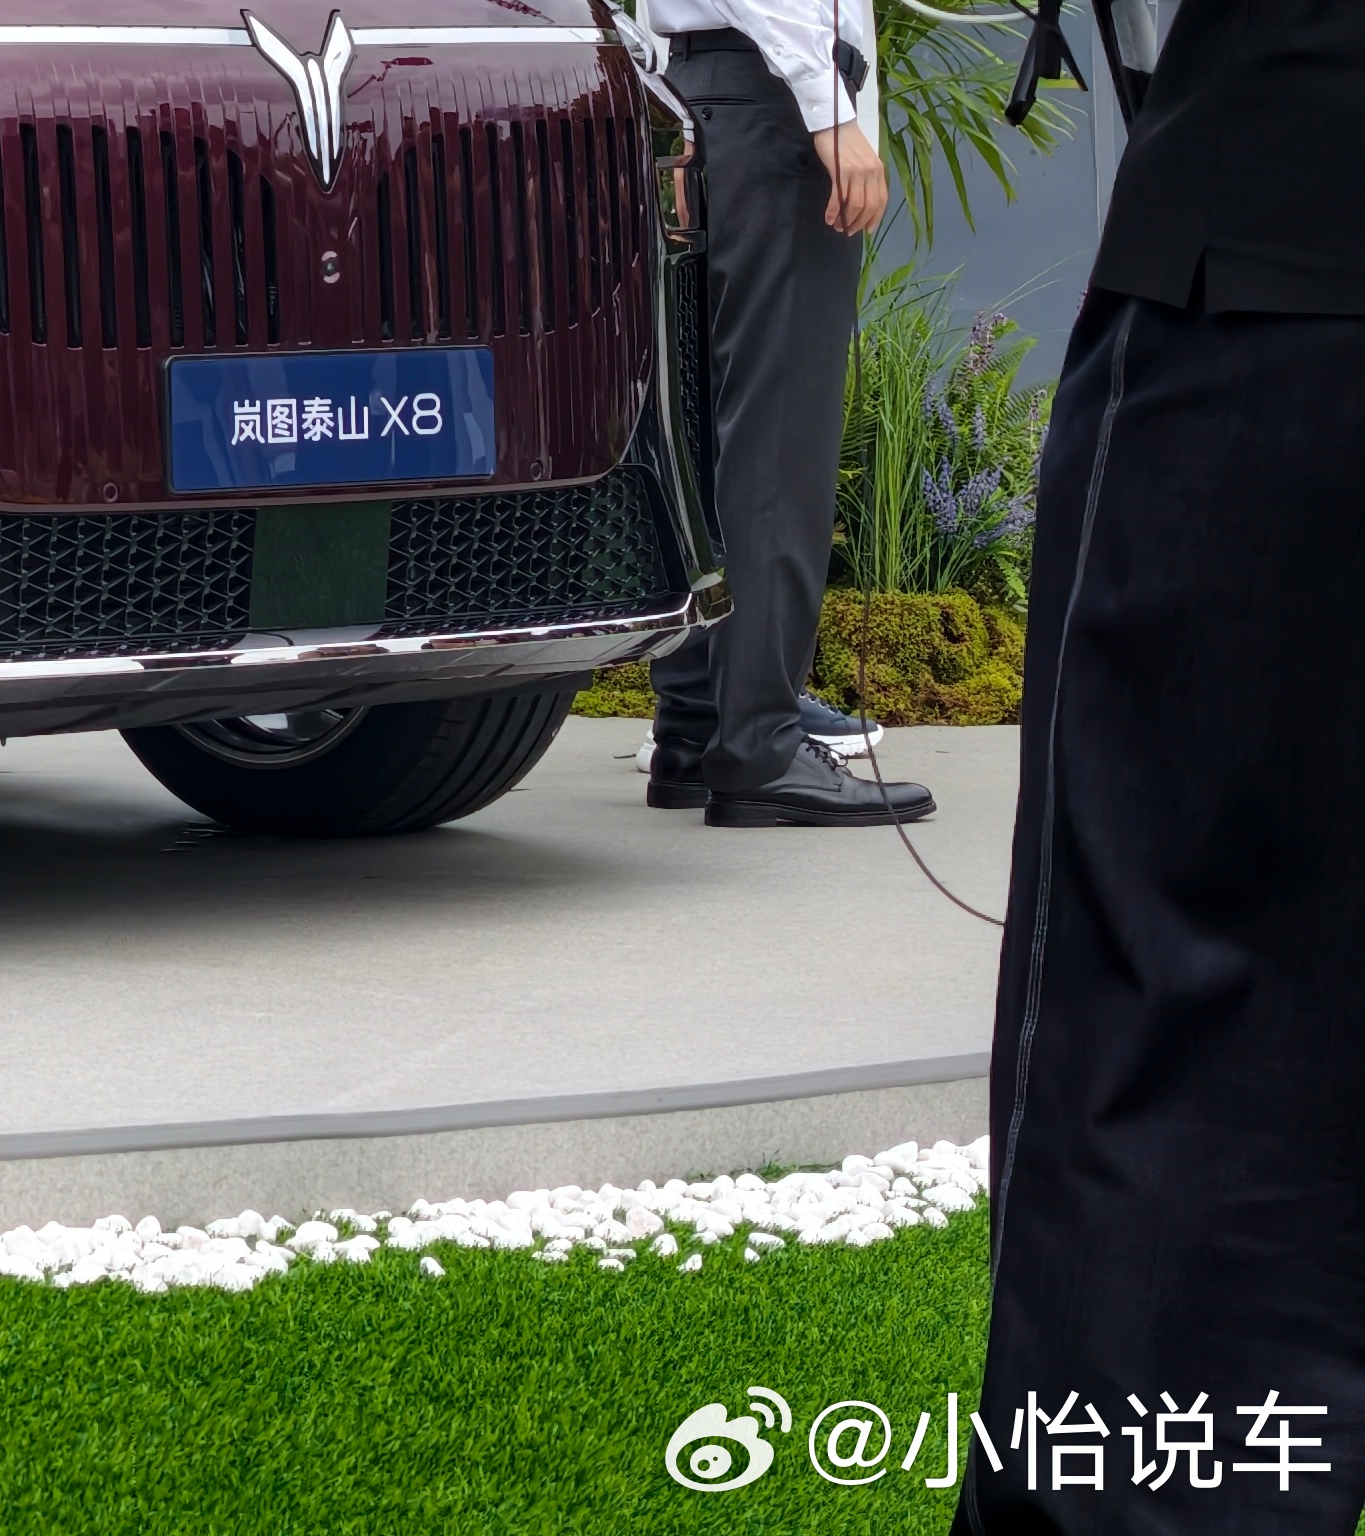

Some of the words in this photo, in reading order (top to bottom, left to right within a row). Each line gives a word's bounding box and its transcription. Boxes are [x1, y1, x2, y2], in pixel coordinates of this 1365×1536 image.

[231, 395, 369, 445] 岚图泰山
[379, 392, 443, 436] X8
